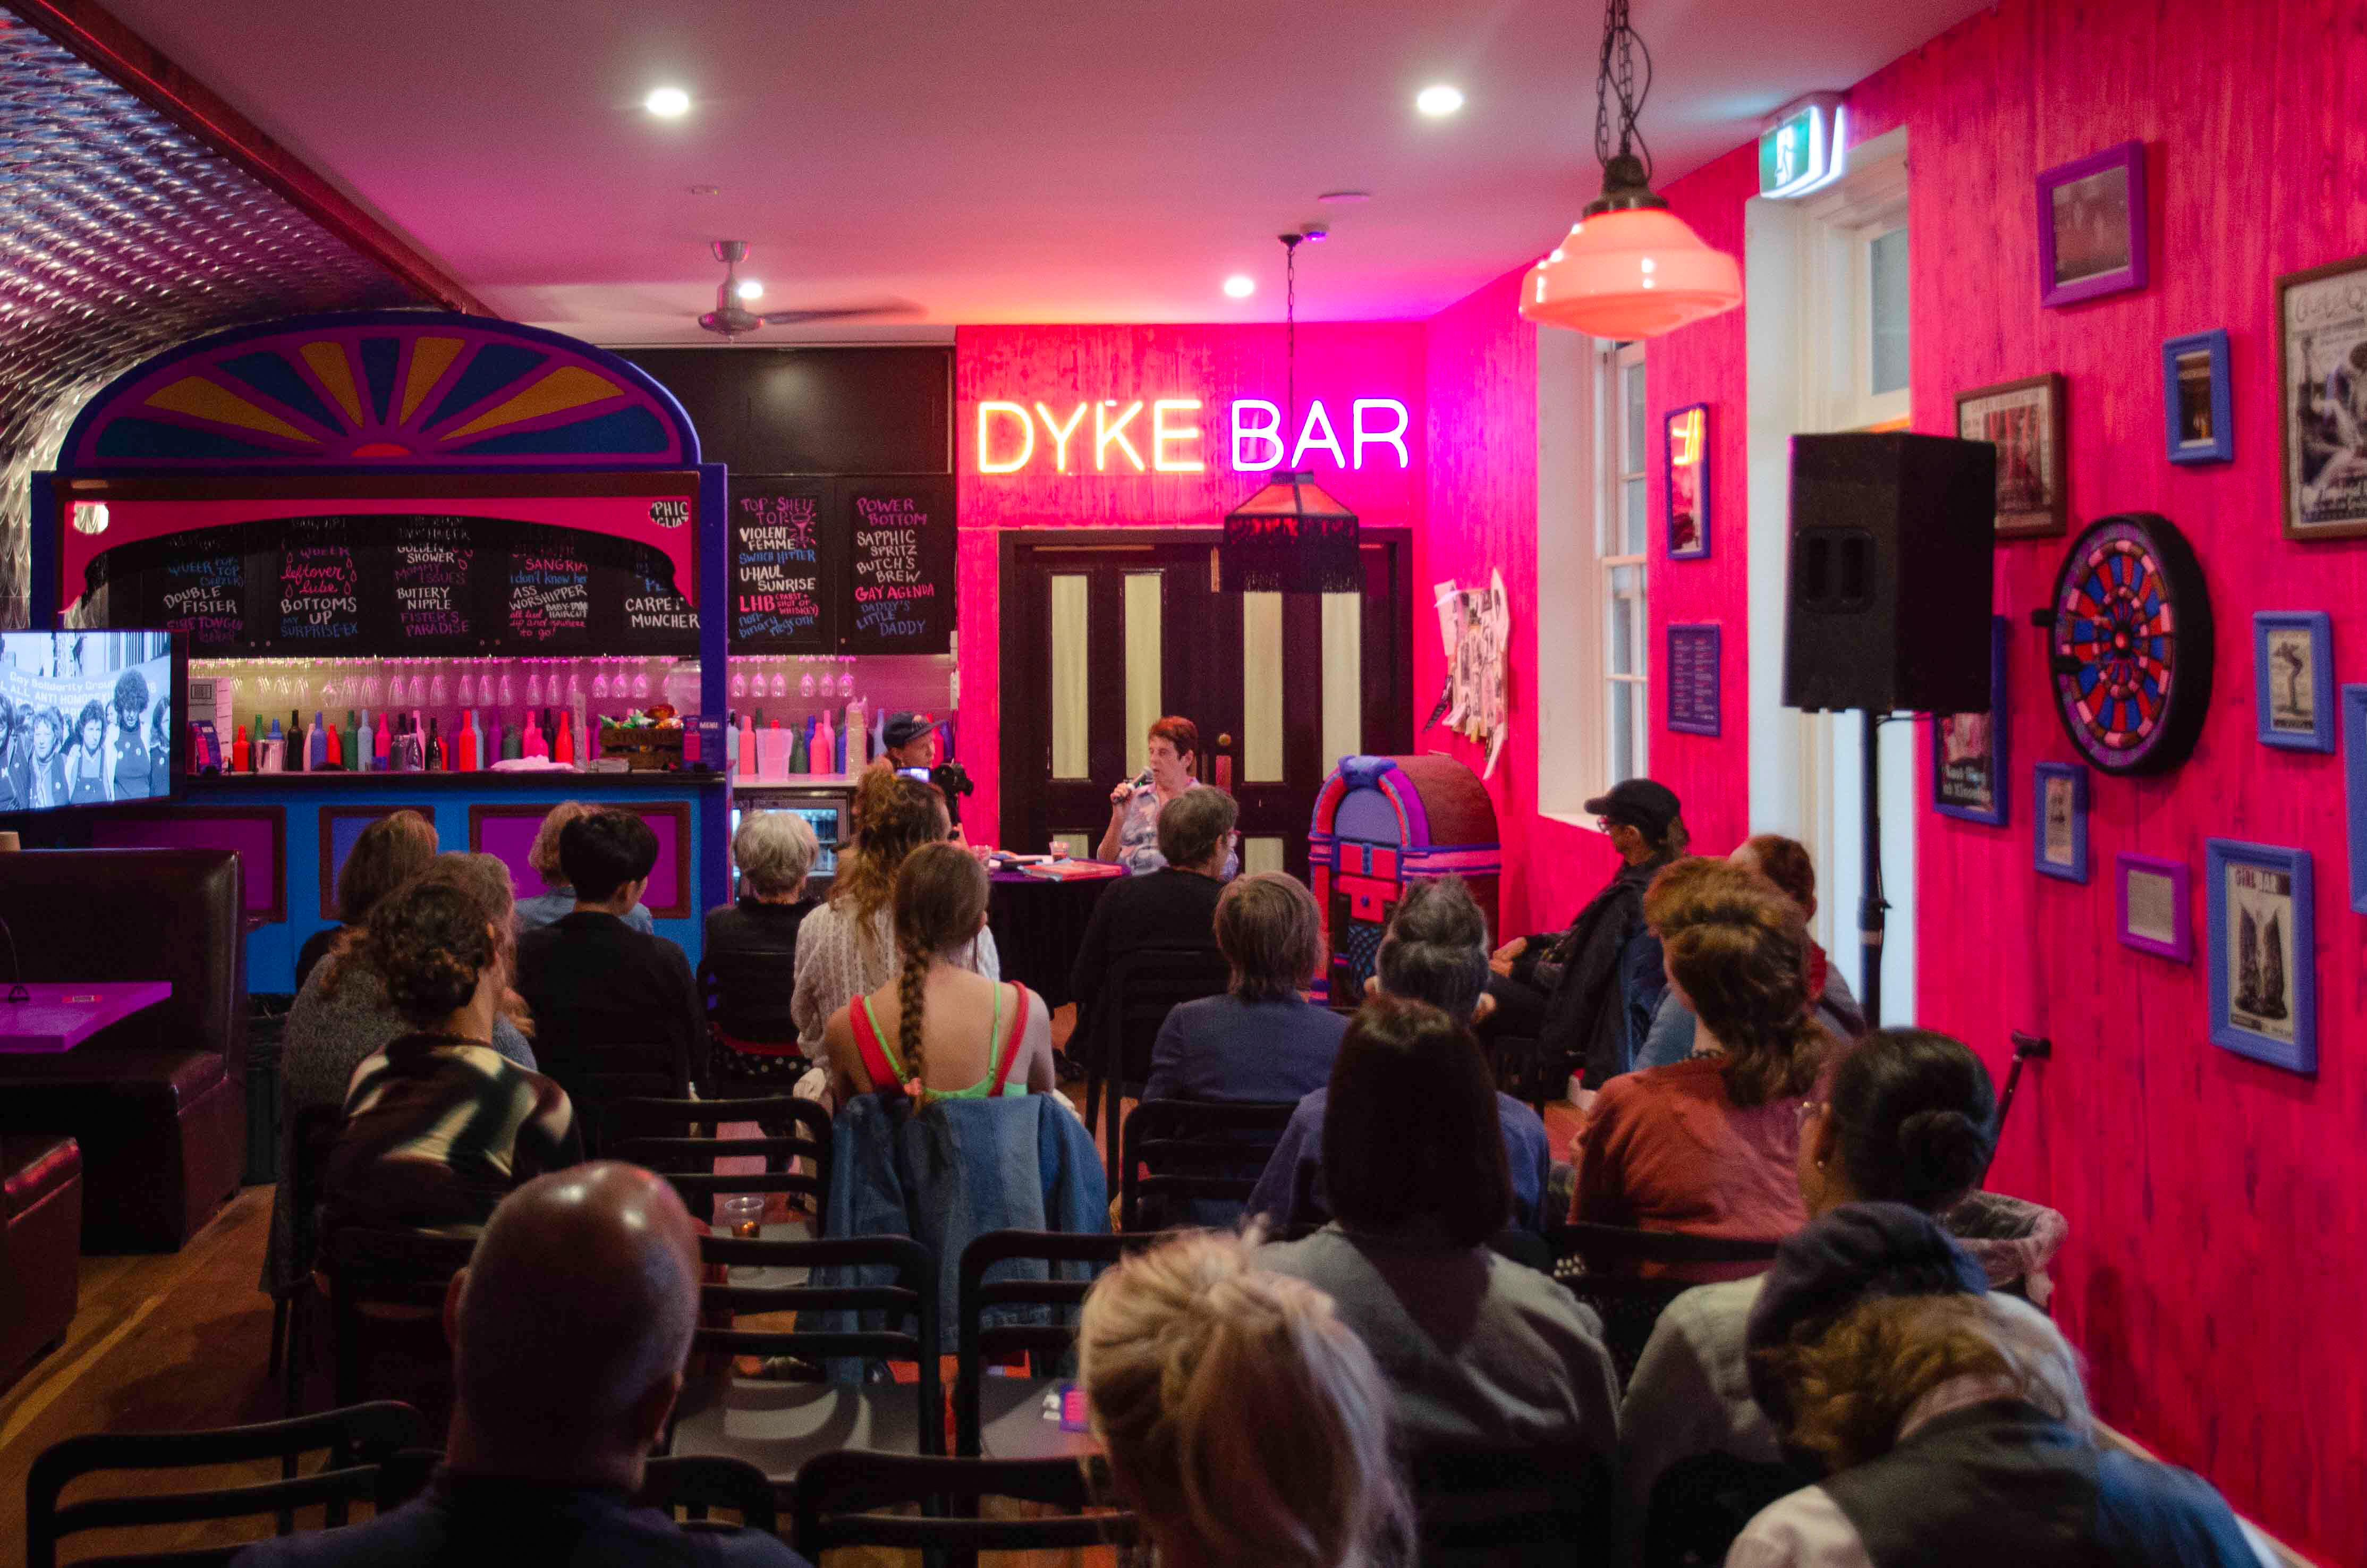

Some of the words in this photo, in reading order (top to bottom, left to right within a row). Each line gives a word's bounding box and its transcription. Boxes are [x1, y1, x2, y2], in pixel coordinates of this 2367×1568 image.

[977, 398, 1205, 474] DYKE
[1231, 397, 1410, 472] BAR
[652, 501, 689, 516] PHIC
[855, 497, 914, 515] POWER
[756, 511, 788, 525] TOP
[867, 512, 927, 527] BOTTOM
[739, 526, 788, 543] VIOLENT
[857, 529, 915, 546] SAPPHIC
[748, 538, 795, 551] FEMME
[870, 545, 918, 557] SPRITZ
[408, 552, 454, 564] SHOWER
[524, 557, 588, 572] SANGRIA
[856, 556, 915, 574] BUTCH'S
[740, 564, 784, 582] U-HAUL
[876, 570, 921, 583] BREW
[513, 585, 538, 599] ASS
[757, 577, 816, 592] SUNRISE
[854, 585, 884, 602] GAY
[887, 582, 935, 599] AGENDA
[163, 586, 221, 609] DOUBLE
[396, 587, 450, 599] BUTTERY
[509, 584, 588, 611] WORSHIPPER
[183, 599, 237, 614] FISTER
[281, 596, 358, 614] BOTTOMS
[408, 599, 451, 610] NIPPLE
[740, 595, 775, 612] LHB
[309, 611, 332, 625] UP
[631, 613, 700, 629] MUNCHER
[880, 618, 926, 636] DADDY
[31, 679, 83, 693] Solidarity
